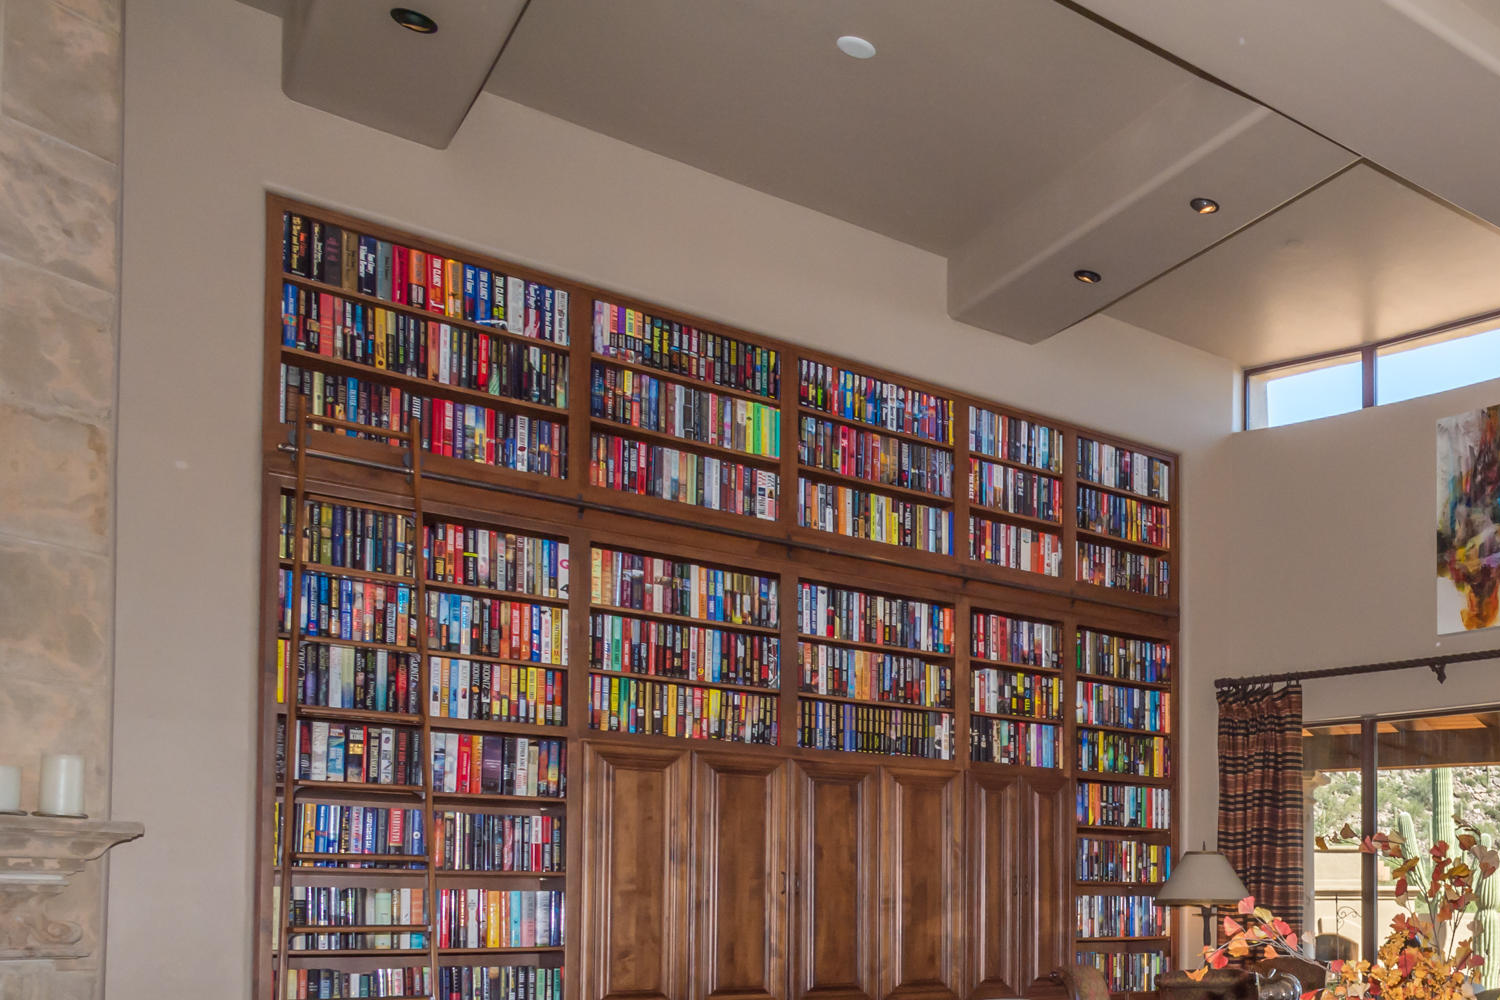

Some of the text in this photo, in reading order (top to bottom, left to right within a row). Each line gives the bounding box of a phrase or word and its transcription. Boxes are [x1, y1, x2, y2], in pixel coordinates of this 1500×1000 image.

[432, 258, 442, 288] TOM CLANCY
[479, 271, 488, 300] TOM CLANCY
[495, 276, 504, 288] TOM
[495, 287, 504, 307] CLANCY
[482, 663, 491, 690] KOONTZ
